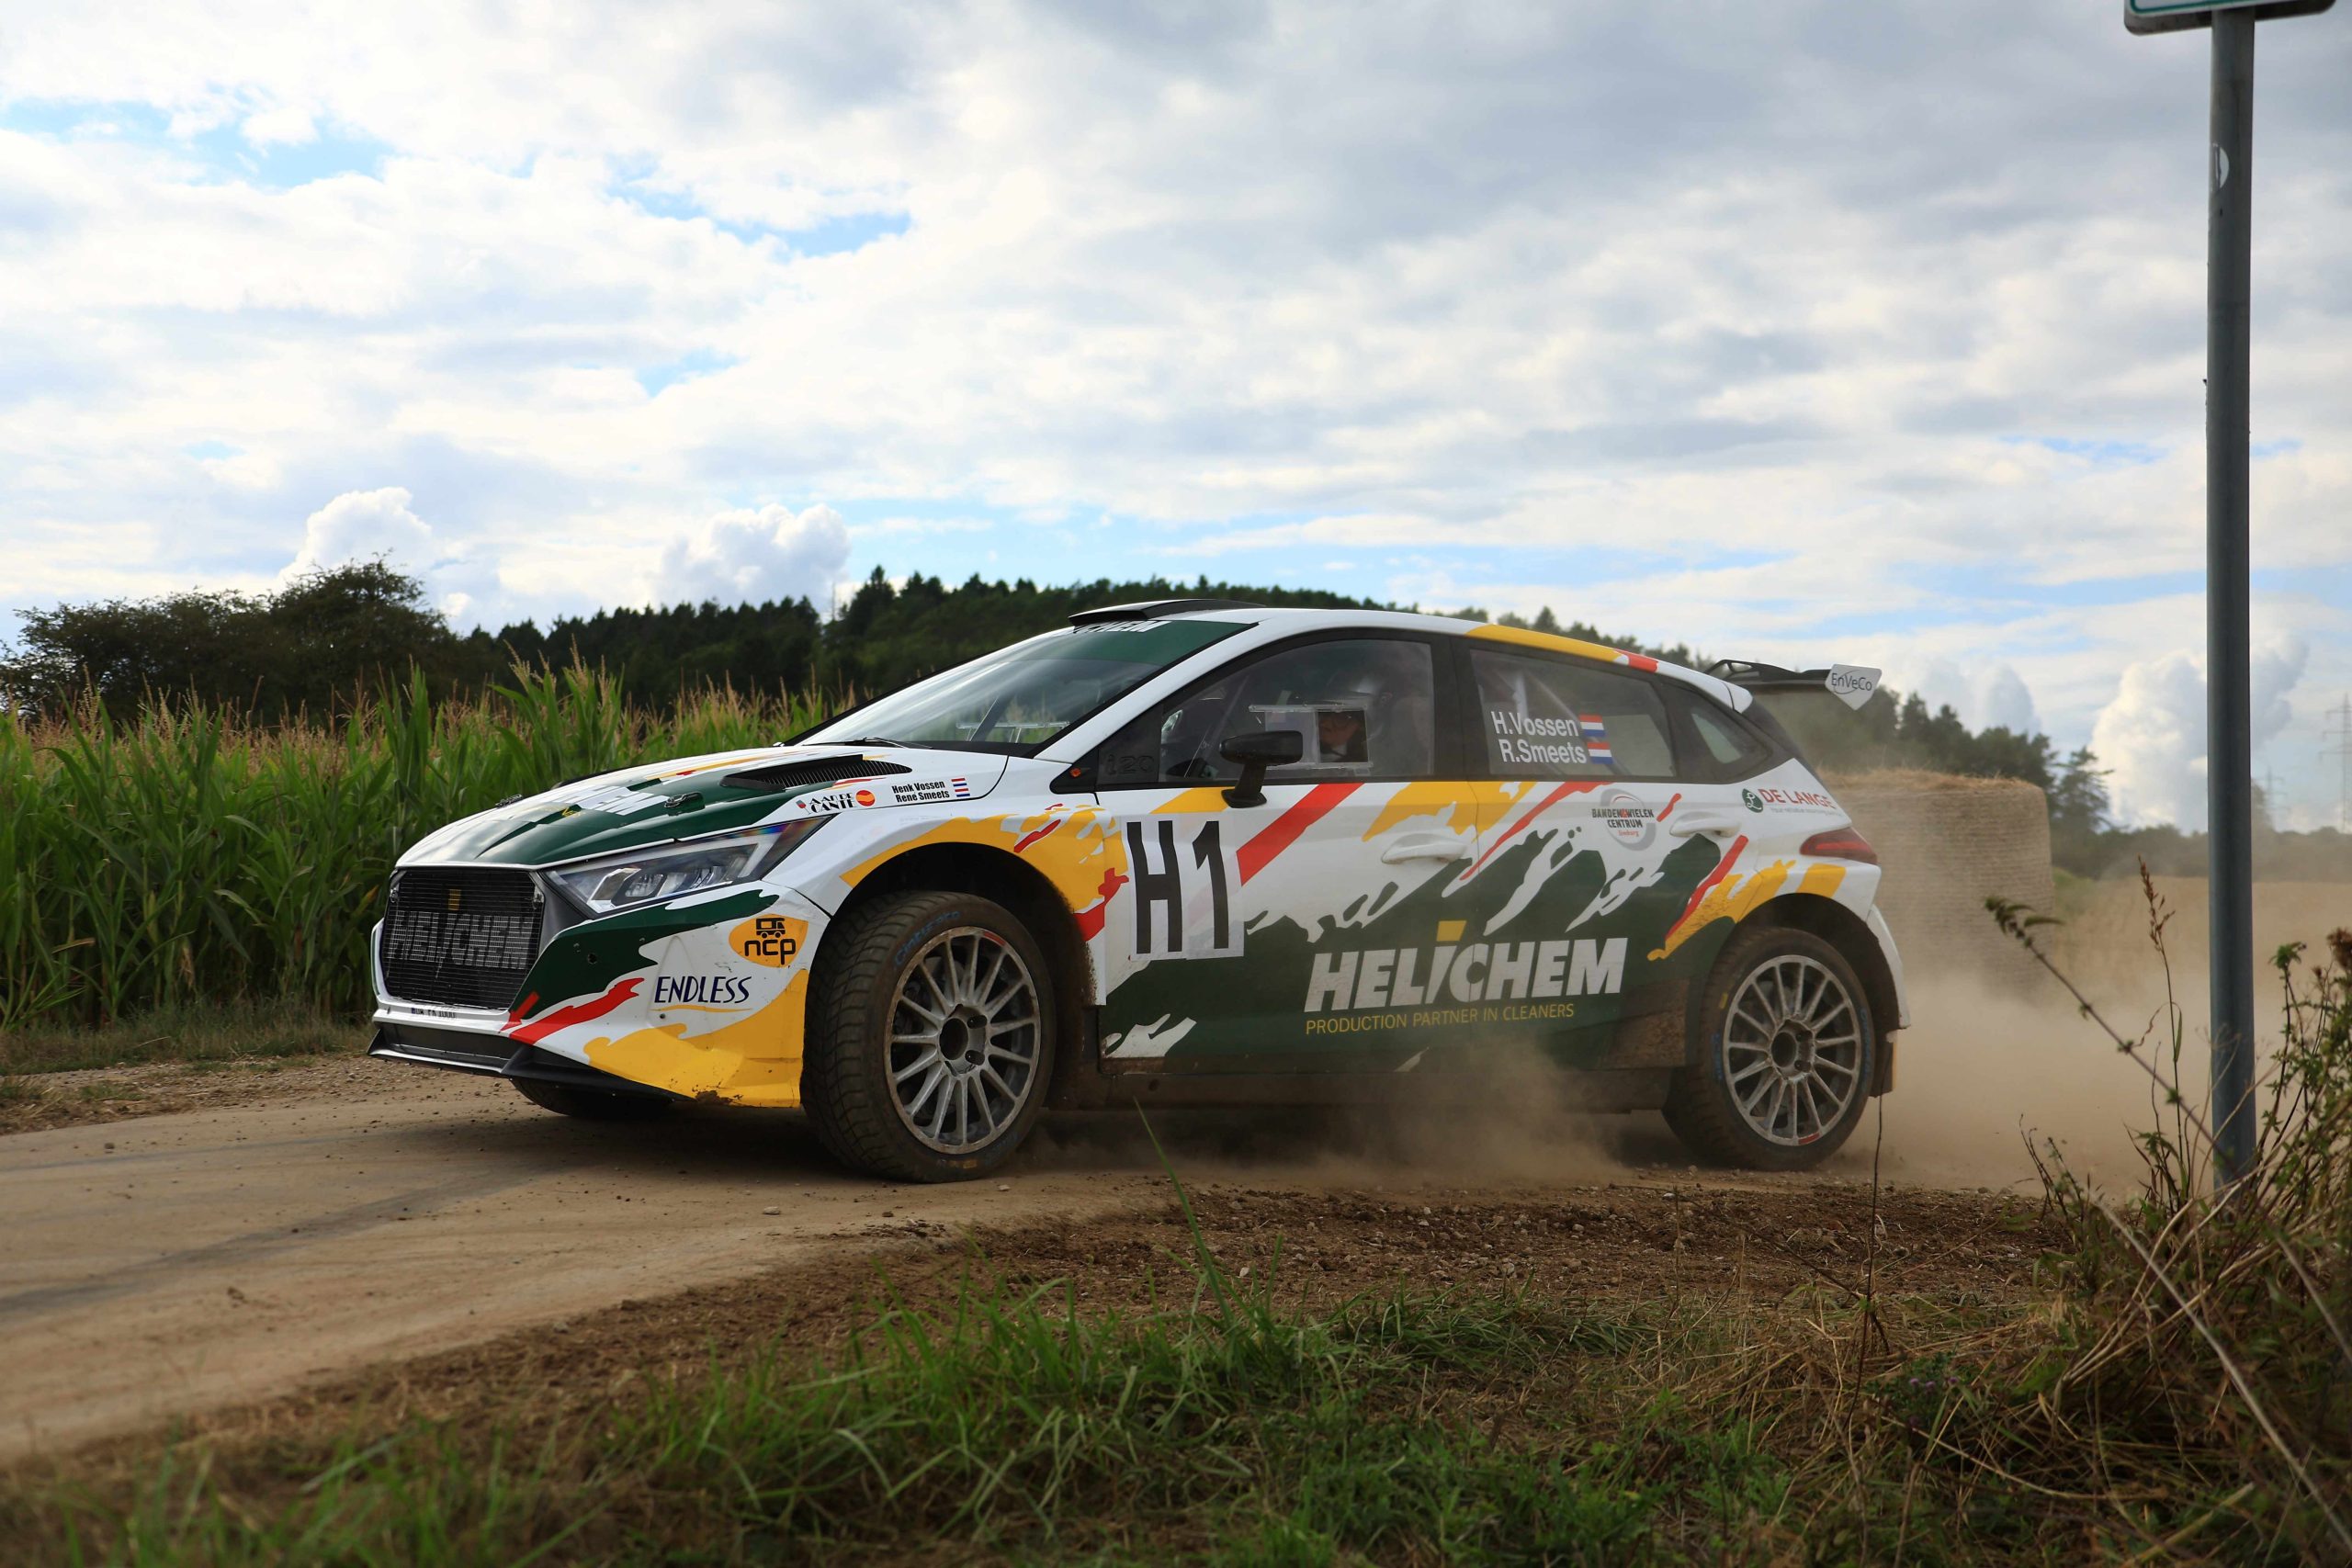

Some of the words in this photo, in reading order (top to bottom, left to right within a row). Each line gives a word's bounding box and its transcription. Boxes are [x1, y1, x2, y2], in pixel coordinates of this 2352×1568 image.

[1831, 672, 1872, 692] EnVeCo
[1490, 710, 1579, 737] H.Vossen
[1498, 739, 1588, 764] R.Smeets
[891, 784, 915, 795] Henk
[913, 781, 945, 792] Vossen
[918, 790, 950, 801] Smeets
[1758, 788, 1786, 804] DE
[1782, 790, 1838, 809] LANGE
[1607, 819, 1643, 829] CENTRUM
[1126, 820, 1229, 954] H1
[744, 938, 797, 965] ncp
[654, 976, 752, 1003] ENDLESS
[1306, 1013, 1408, 1035] PRODUCTION
[1412, 1008, 1478, 1027] PARTNER
[1483, 1007, 1498, 1021] IN
[1502, 1003, 1575, 1021] CLEANERS
